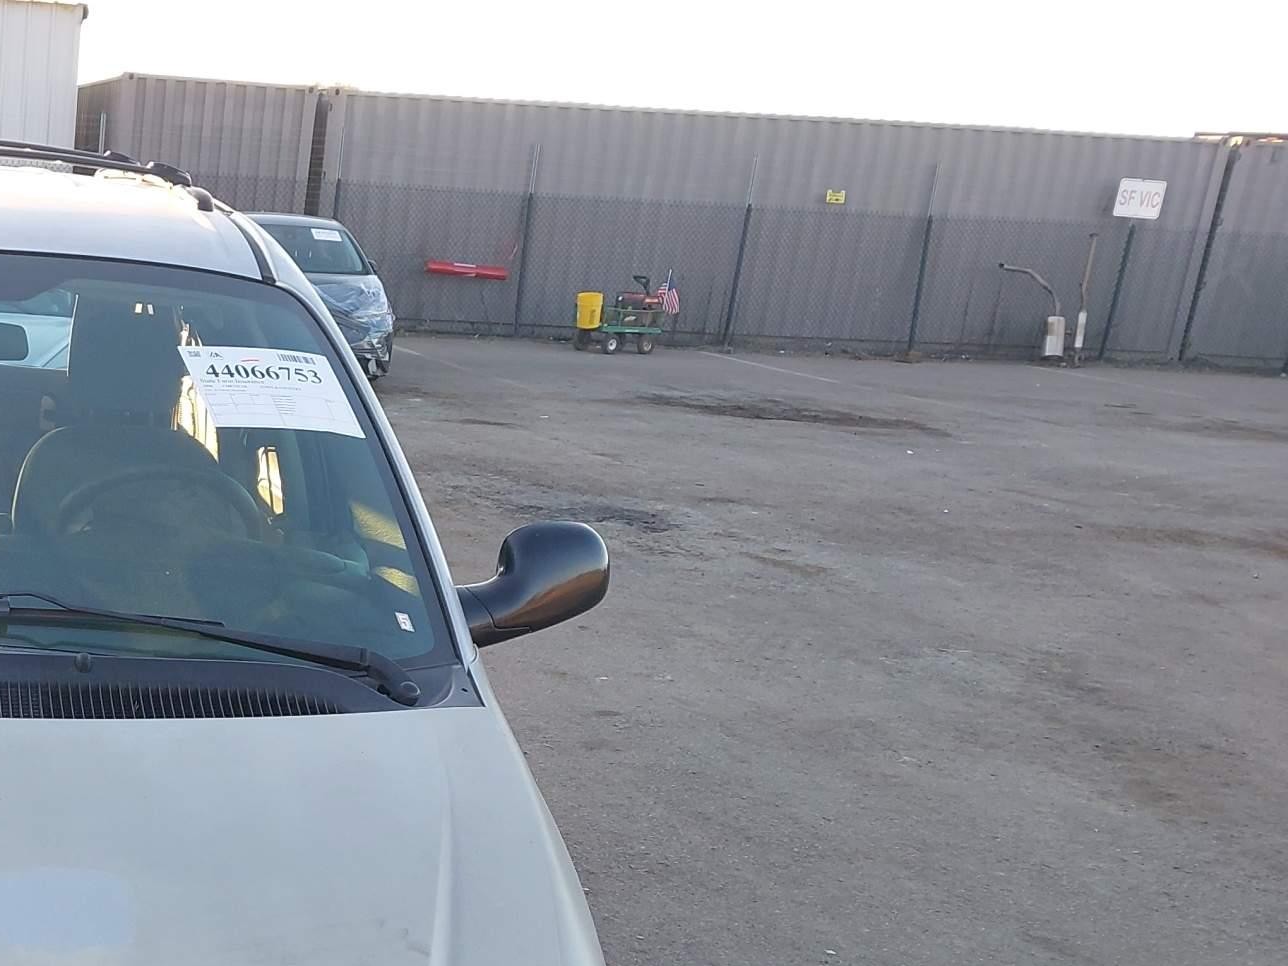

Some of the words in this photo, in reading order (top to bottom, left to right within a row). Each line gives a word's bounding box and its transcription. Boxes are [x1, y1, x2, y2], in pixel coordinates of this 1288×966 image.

[1119, 189, 1137, 206] SF
[1140, 191, 1161, 208] VIC
[205, 363, 322, 384] 44066753
